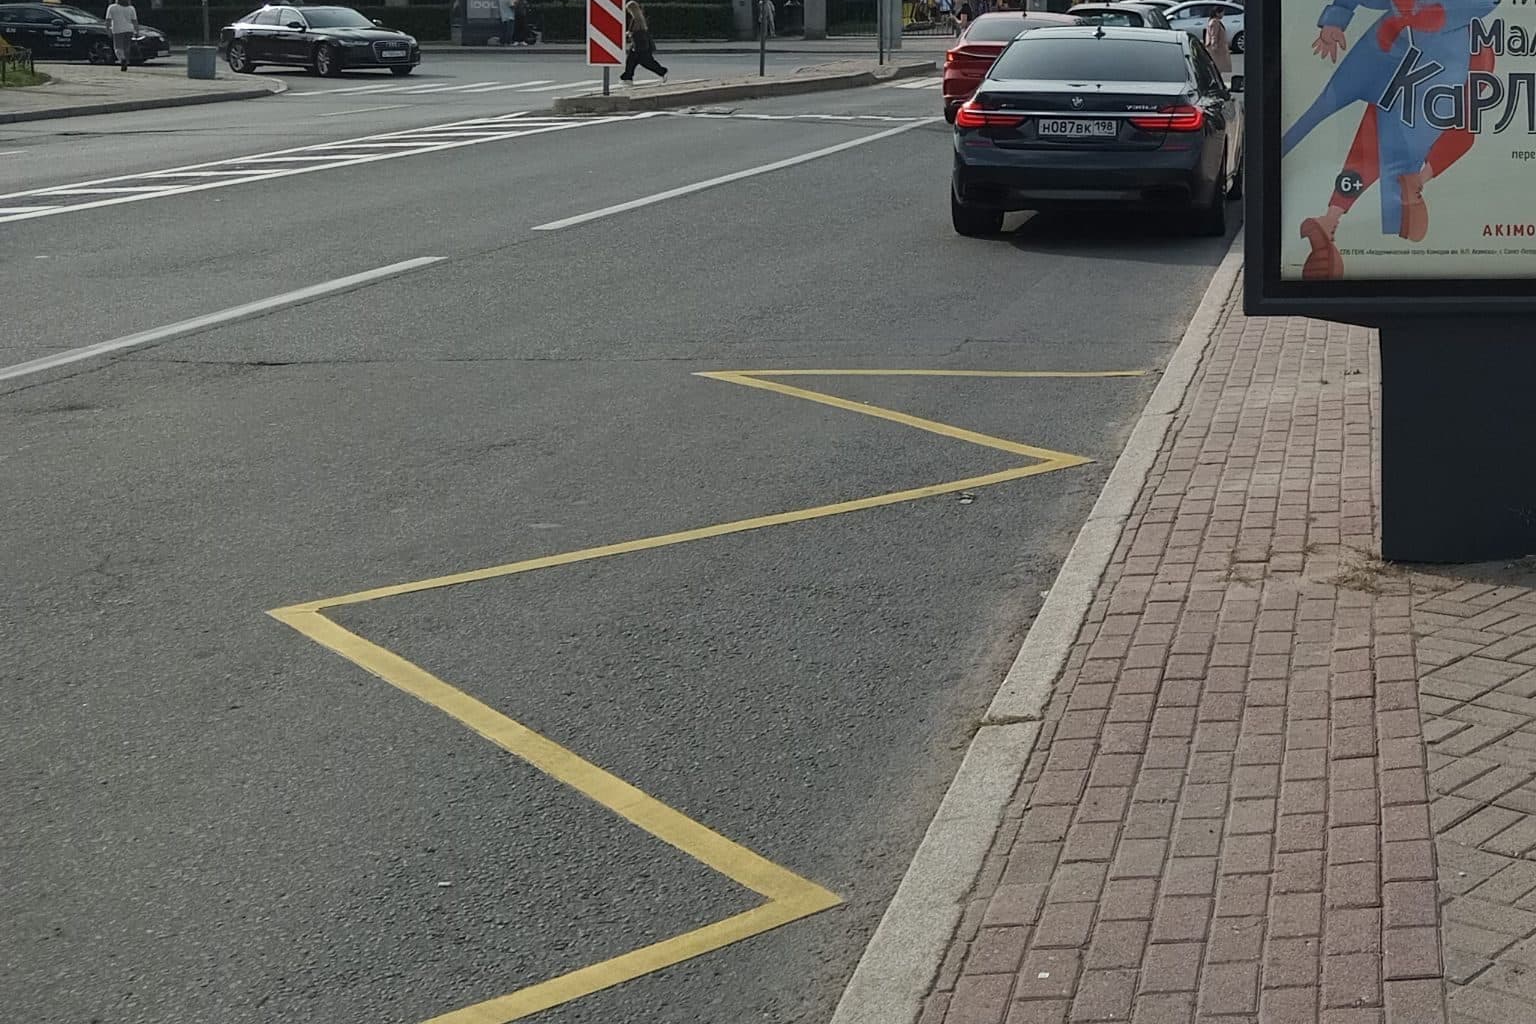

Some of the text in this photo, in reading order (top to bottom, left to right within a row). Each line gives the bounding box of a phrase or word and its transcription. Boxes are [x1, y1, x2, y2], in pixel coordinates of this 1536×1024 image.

[1041, 120, 1113, 134] Н087ВК 198
[1341, 177, 1363, 192] 6+
